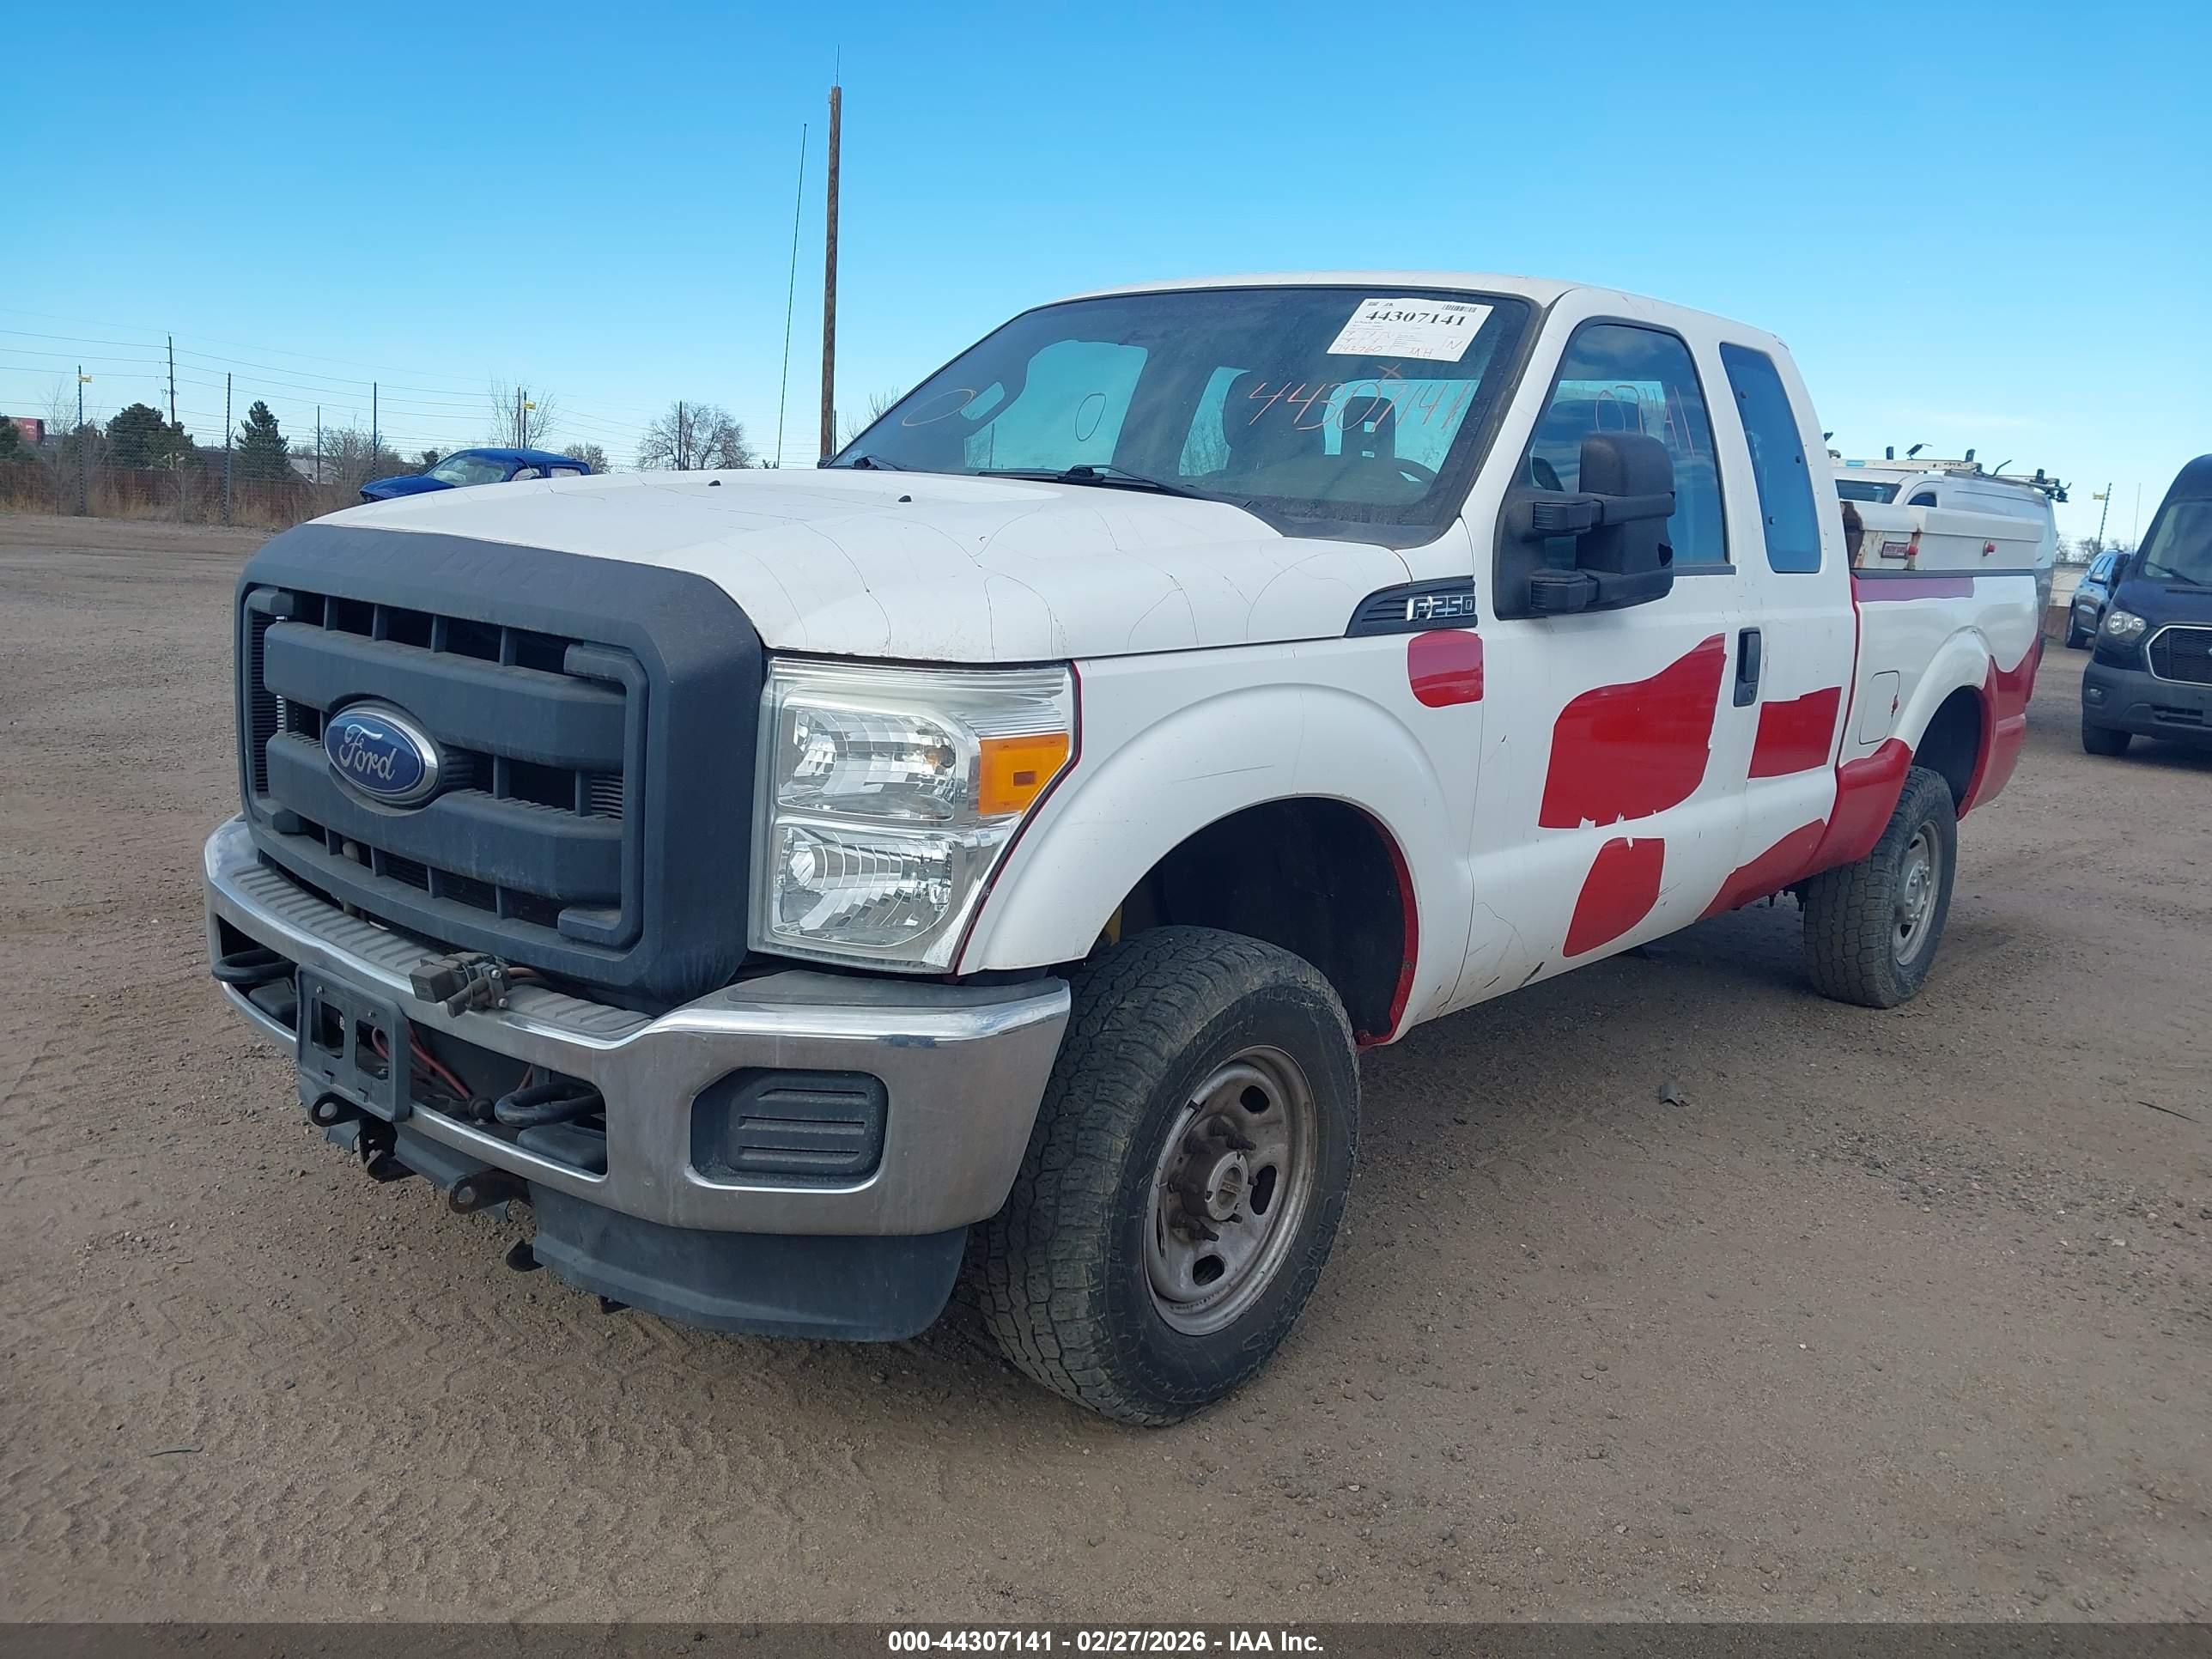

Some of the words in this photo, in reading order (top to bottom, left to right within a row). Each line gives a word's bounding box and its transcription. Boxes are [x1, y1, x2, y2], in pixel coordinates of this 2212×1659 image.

[1365, 310, 1467, 326] 44307141
[1407, 595, 1477, 622] F-250
[338, 723, 398, 781] Ford
